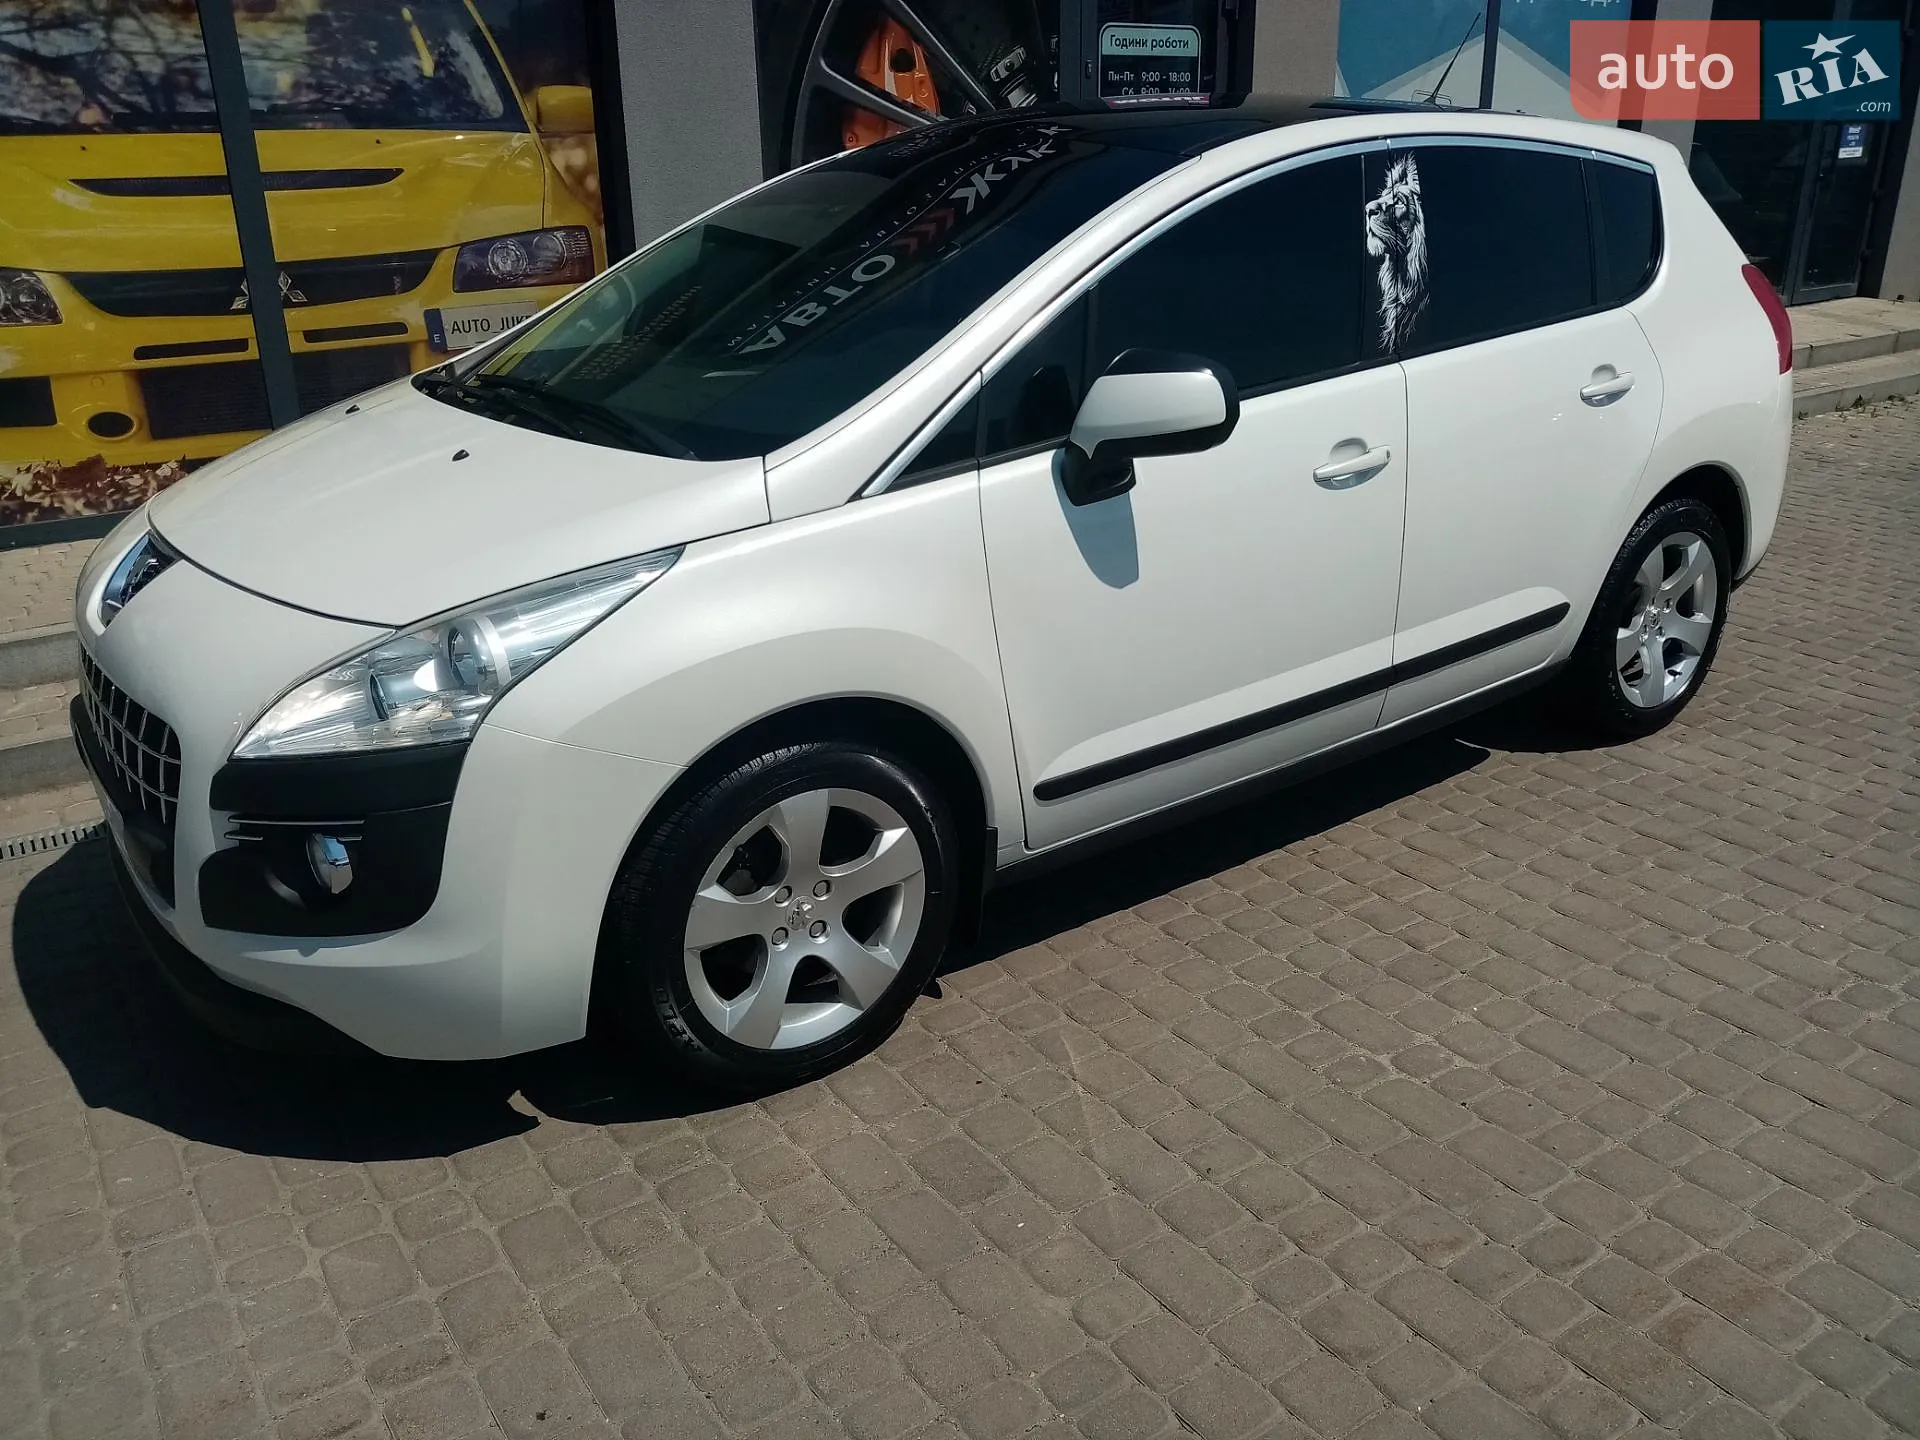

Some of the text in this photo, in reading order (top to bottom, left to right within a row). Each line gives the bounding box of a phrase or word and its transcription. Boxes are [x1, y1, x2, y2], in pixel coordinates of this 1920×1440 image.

[1110, 34, 1189, 51] Години роботи
[1108, 71, 1135, 81] Пн-Пт
[1141, 71, 1160, 82] 9:00
[1168, 72, 1191, 82] 18:00
[451, 315, 533, 335] AUTO_JUK
[434, 334, 441, 343] E
